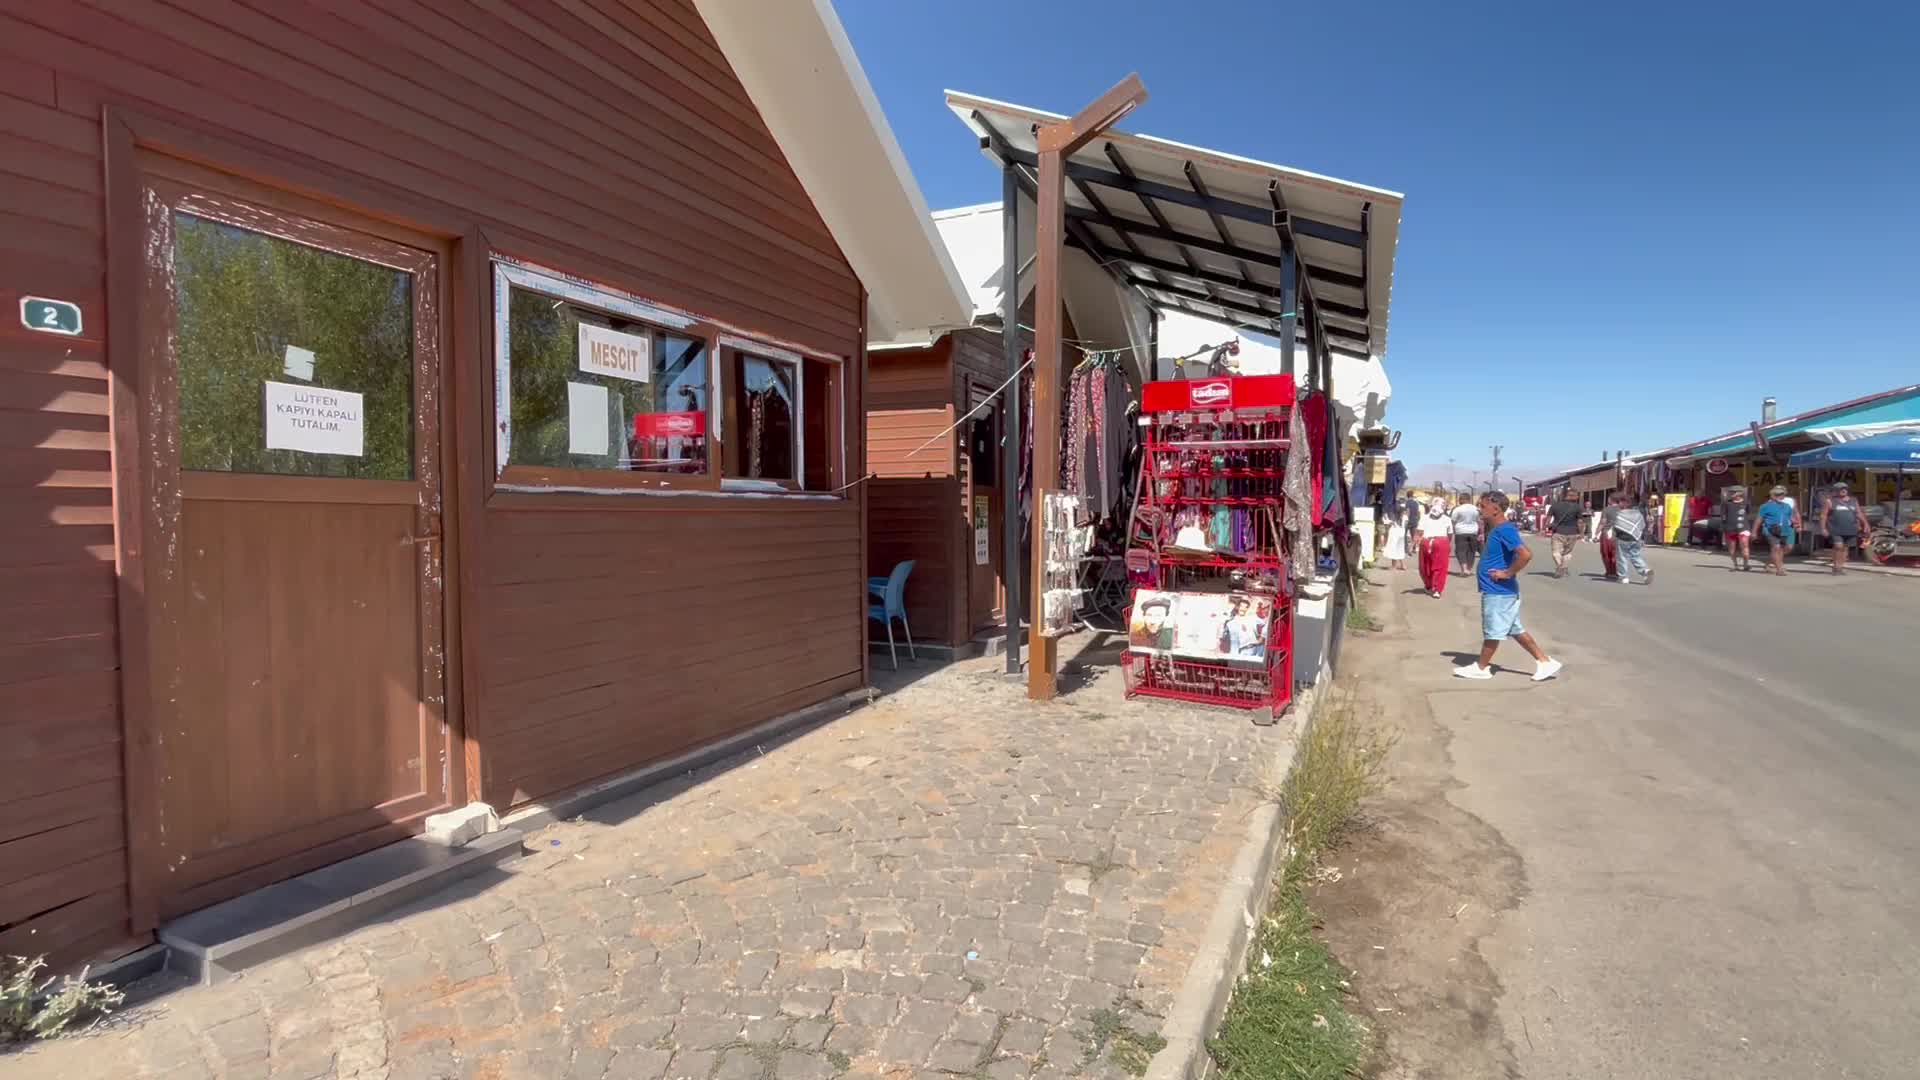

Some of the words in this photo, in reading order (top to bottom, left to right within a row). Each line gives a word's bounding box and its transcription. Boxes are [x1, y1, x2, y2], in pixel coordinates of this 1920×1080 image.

[43, 306, 58, 325] 2
[276, 403, 314, 417] KAPIYI
[317, 408, 357, 422] KAPALI
